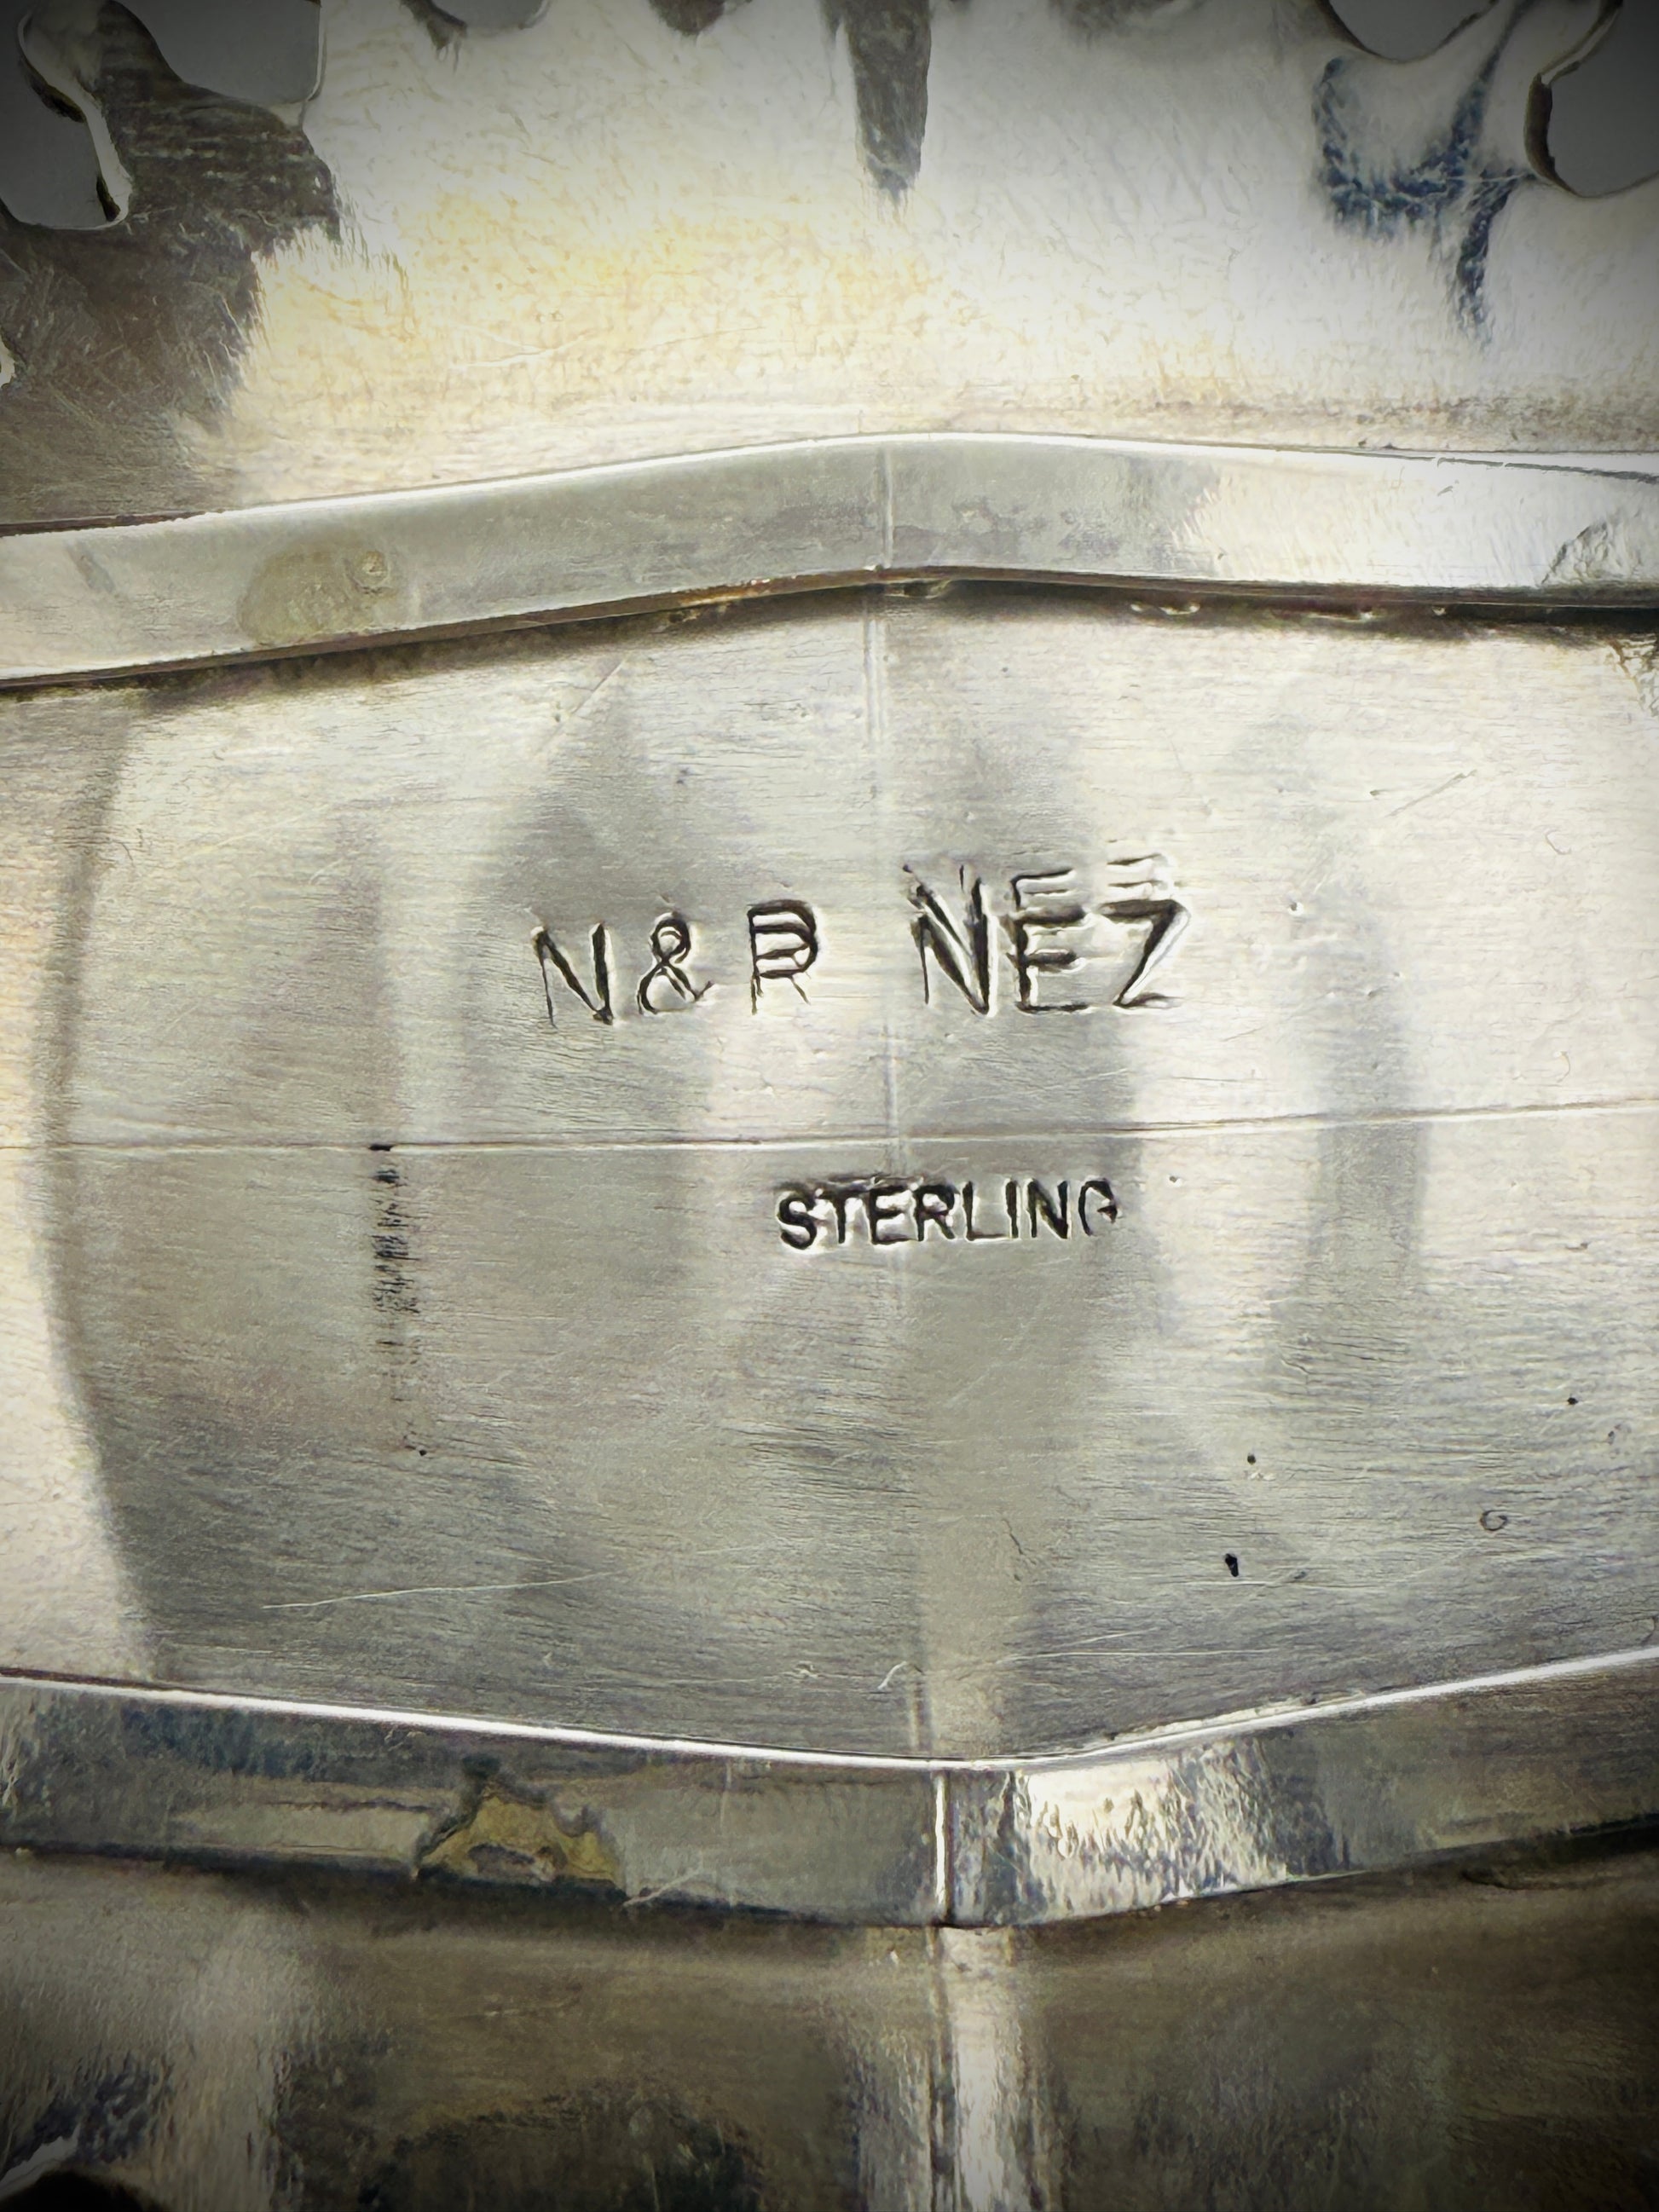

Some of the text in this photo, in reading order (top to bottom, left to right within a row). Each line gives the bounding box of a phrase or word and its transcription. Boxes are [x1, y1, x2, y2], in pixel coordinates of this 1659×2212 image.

[531, 923, 614, 1030] N
[637, 912, 714, 1014] &
[904, 863, 1190, 1015] NEZ
[776, 1175, 1119, 1250] STERLING
